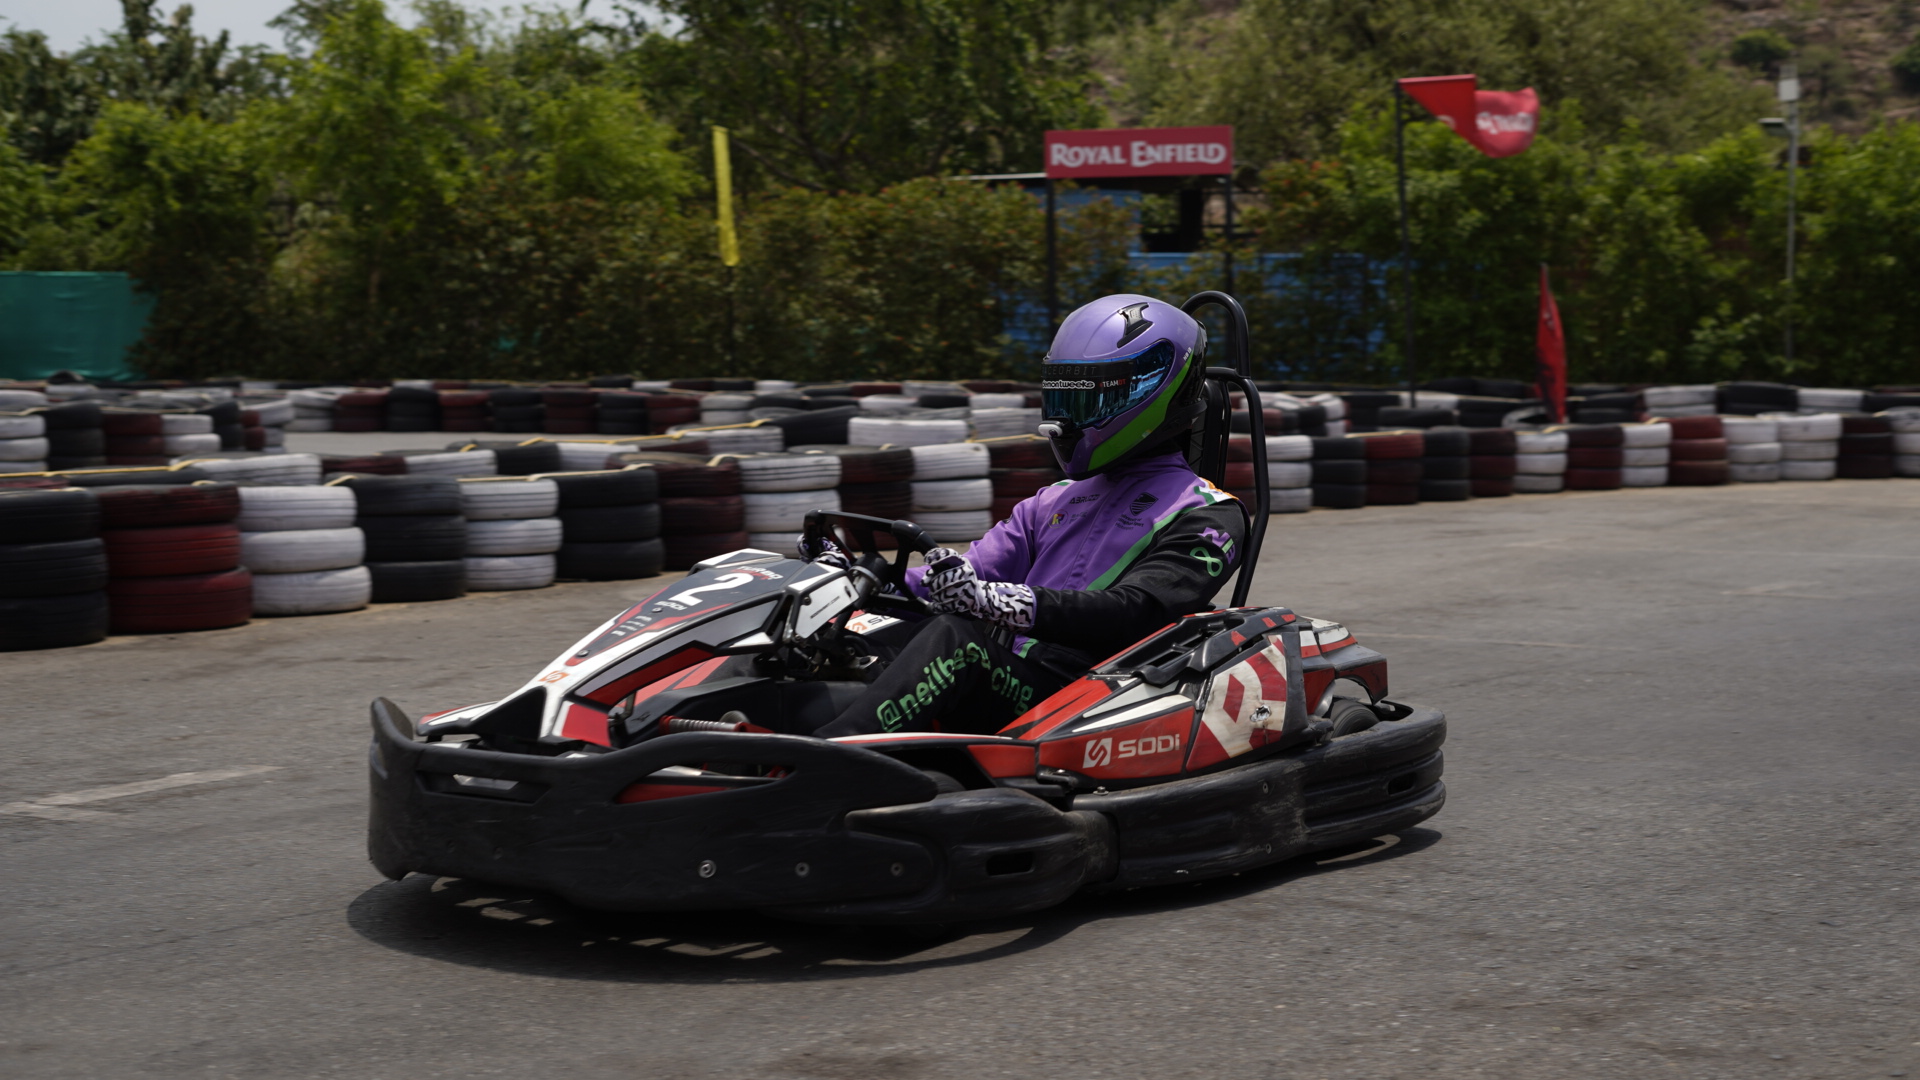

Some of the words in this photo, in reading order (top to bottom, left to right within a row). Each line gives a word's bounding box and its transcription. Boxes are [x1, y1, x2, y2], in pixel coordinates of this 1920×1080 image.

[1050, 142, 1126, 168] ROYAL
[1130, 141, 1227, 167] ENFIELD
[668, 572, 754, 606] 2
